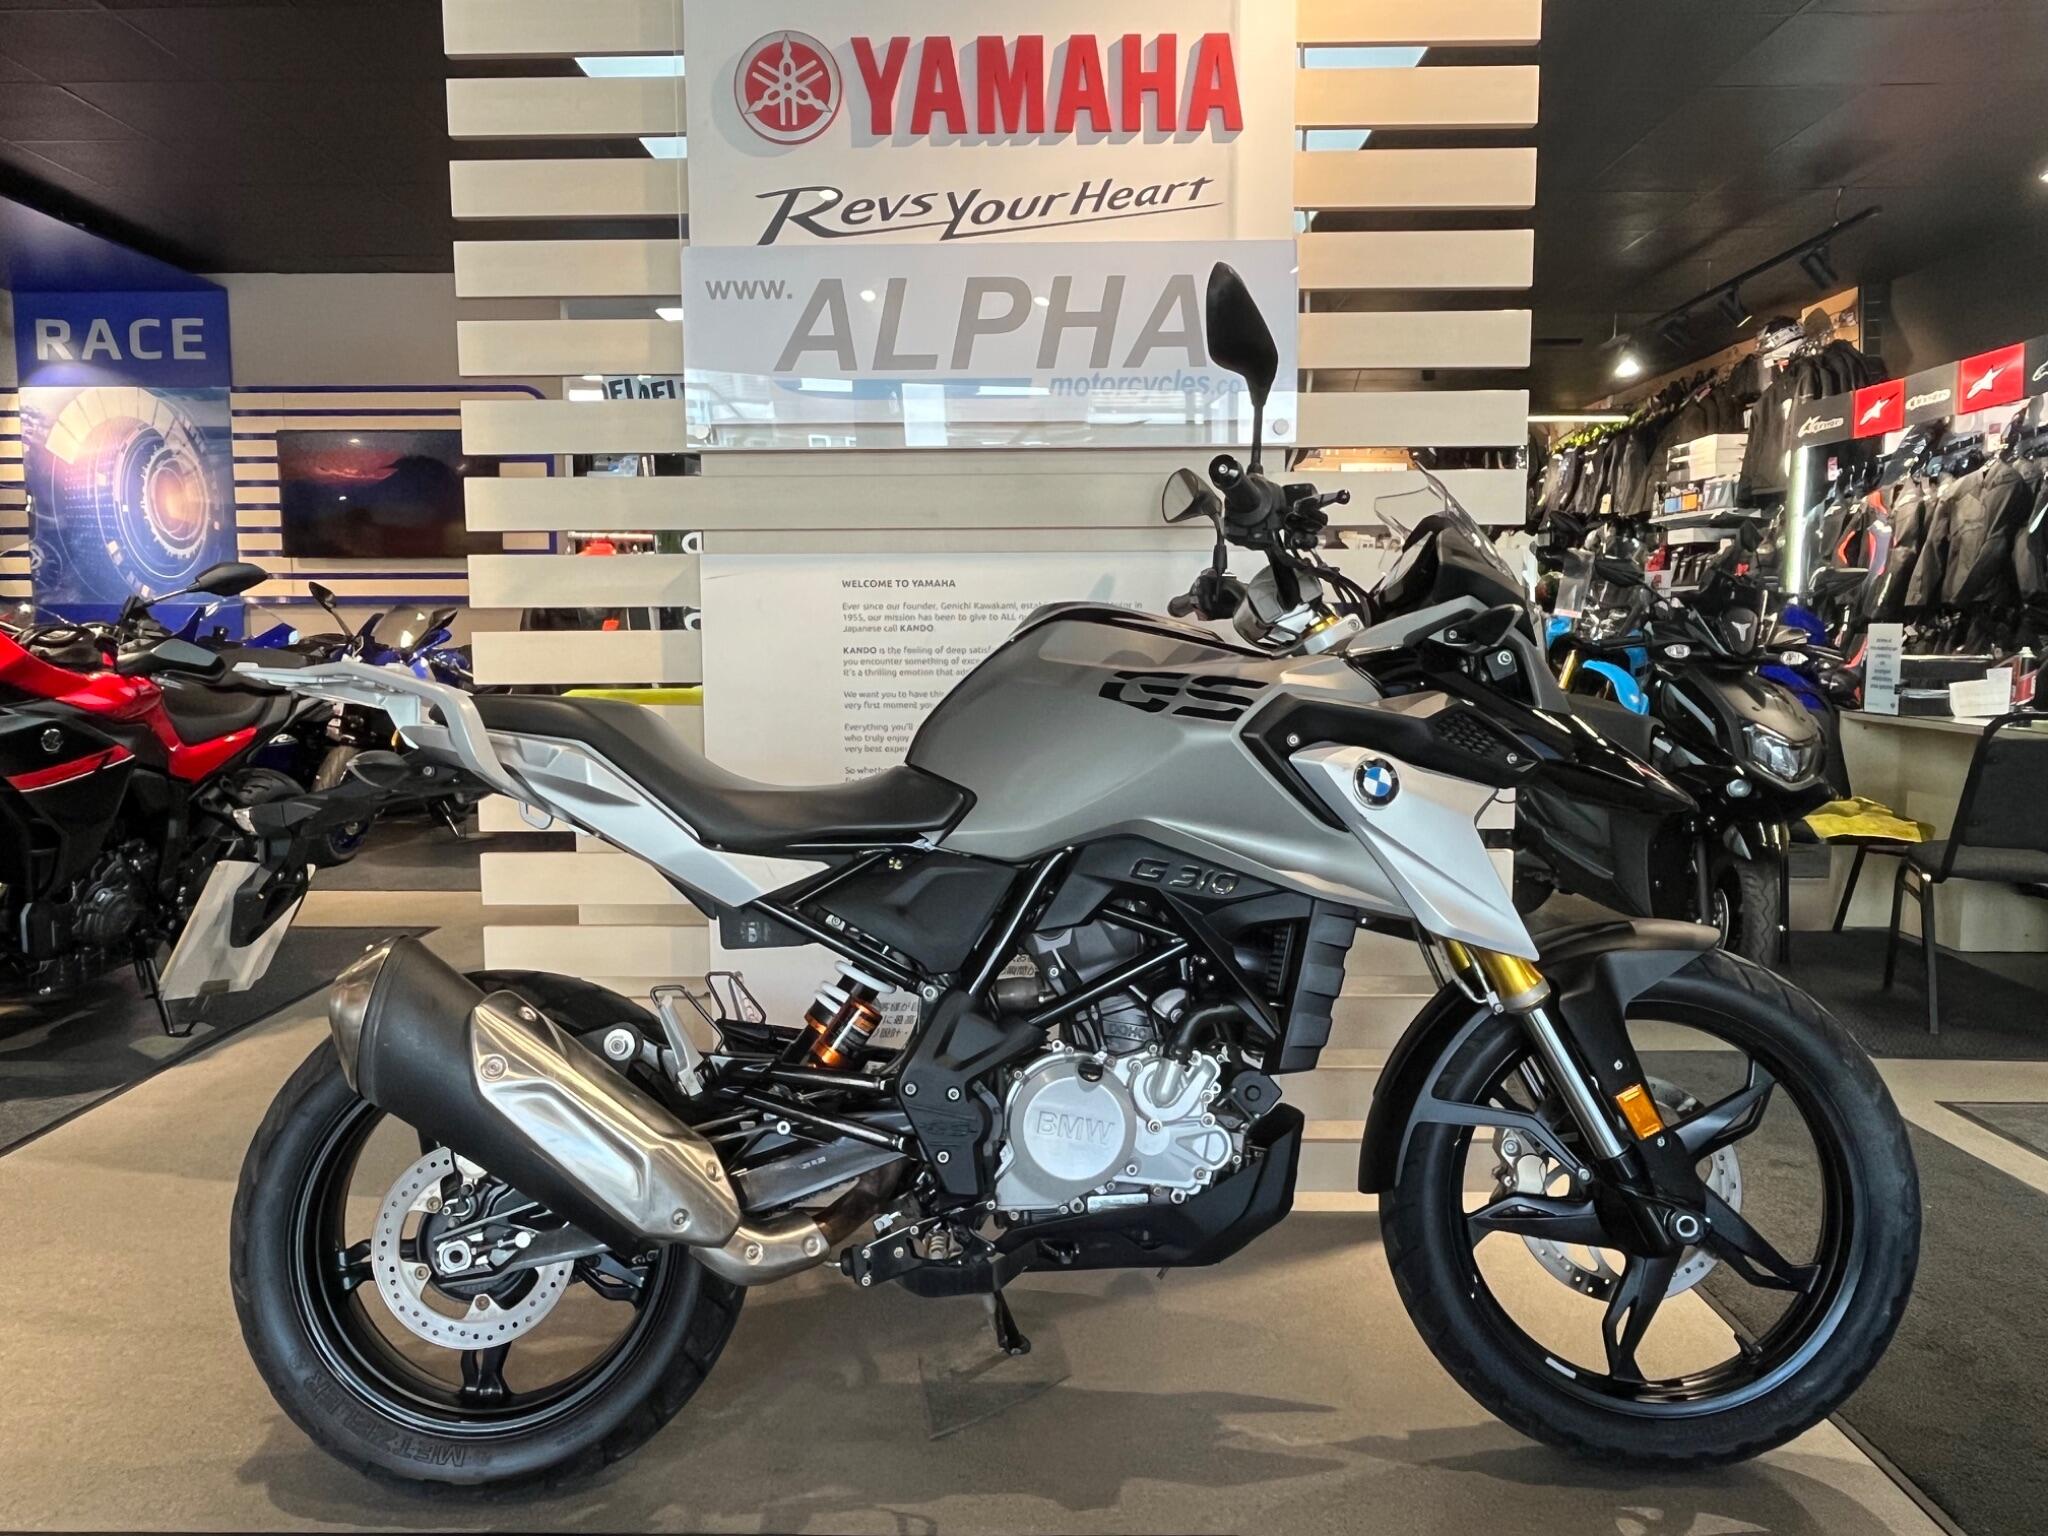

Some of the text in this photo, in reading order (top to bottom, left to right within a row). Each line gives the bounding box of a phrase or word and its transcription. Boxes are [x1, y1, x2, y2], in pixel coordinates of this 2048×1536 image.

[850, 33, 1244, 136] YAMAHA
[754, 176, 1215, 246] Revs Your Heart
[705, 274, 1208, 373] www. ALPHA
[35, 316, 207, 362] RACE
[842, 579, 893, 588] WELCOME
[911, 579, 956, 588] YAMAHA
[842, 602, 860, 611] Ever
[863, 602, 884, 611] since
[886, 602, 900, 611] our
[868, 613, 881, 622] our
[884, 613, 916, 622] mission
[918, 613, 933, 622] has
[934, 613, 956, 622] been
[970, 613, 986, 622] give
[1001, 613, 1016, 622] ALL
[843, 624, 882, 633] Japanese
[843, 646, 877, 655] KANDO
[887, 646, 901, 655] the
[903, 646, 933, 655] feeling
[946, 646, 967, 655] deep
[843, 658, 859, 666] you
[860, 658, 902, 666] encounter
[904, 658, 949, 666] something
[864, 668, 897, 677] thrilling
[899, 668, 934, 677] emotion
[936, 668, 953, 677] that
[859, 690, 880, 699] want
[881, 690, 897, 699] you
[908, 690, 928, 699] have
[1098, 671, 1269, 721] GS
[844, 701, 861, 710] very
[863, 701, 880, 710] first
[883, 701, 918, 710] moment
[844, 723, 889, 732] Everything
[844, 734, 910, 743] who truly enjoy
[844, 745, 862, 753] very
[864, 745, 882, 753] best
[1129, 857, 1241, 896] G 310
[1036, 1110, 1116, 1147] BMW
